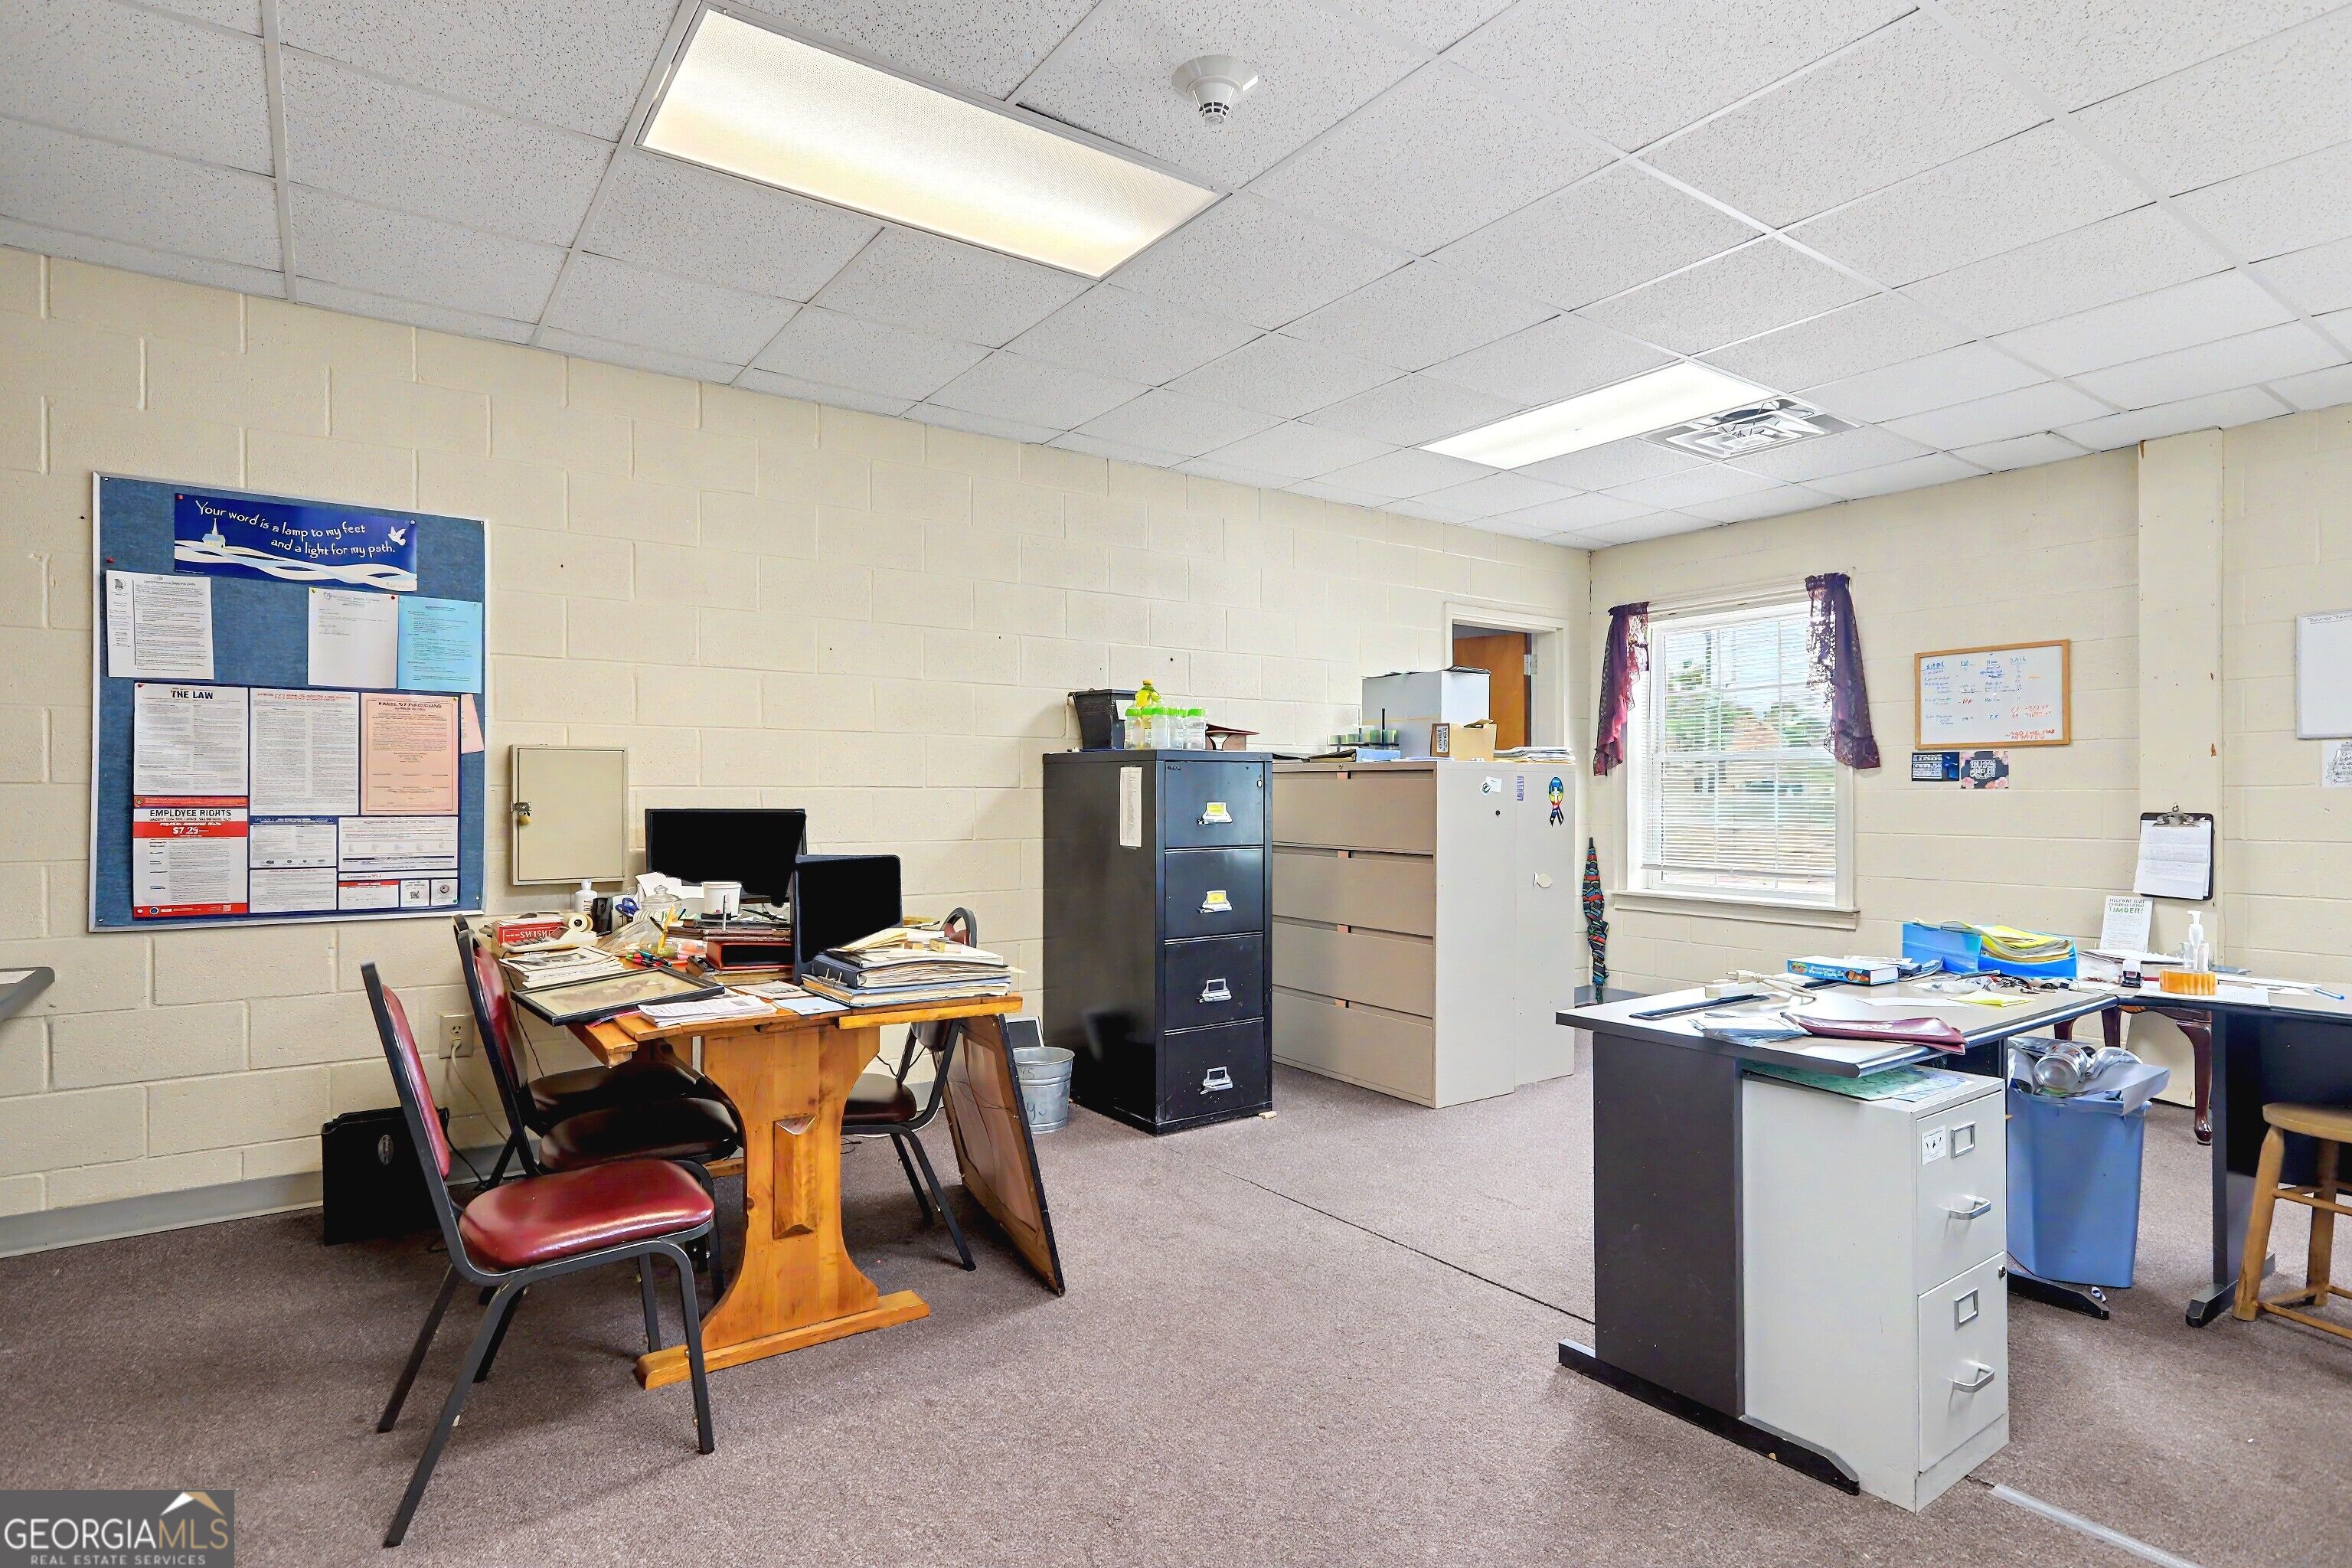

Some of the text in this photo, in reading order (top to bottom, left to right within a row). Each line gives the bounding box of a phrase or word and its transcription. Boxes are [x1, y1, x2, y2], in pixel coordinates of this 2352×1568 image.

[195, 499, 227, 516] Your
[228, 514, 260, 525] word
[260, 518, 269, 529] is
[282, 521, 309, 542] lamp
[311, 528, 323, 537] to
[325, 528, 341, 540] my
[341, 521, 366, 534] feet
[270, 538, 293, 550] and
[305, 541, 328, 559] light
[331, 544, 348, 555] for
[350, 547, 366, 557] my
[368, 540, 396, 558] path.
[192, 691, 214, 700] LAW
[149, 809, 197, 818] EMPLOYEE
